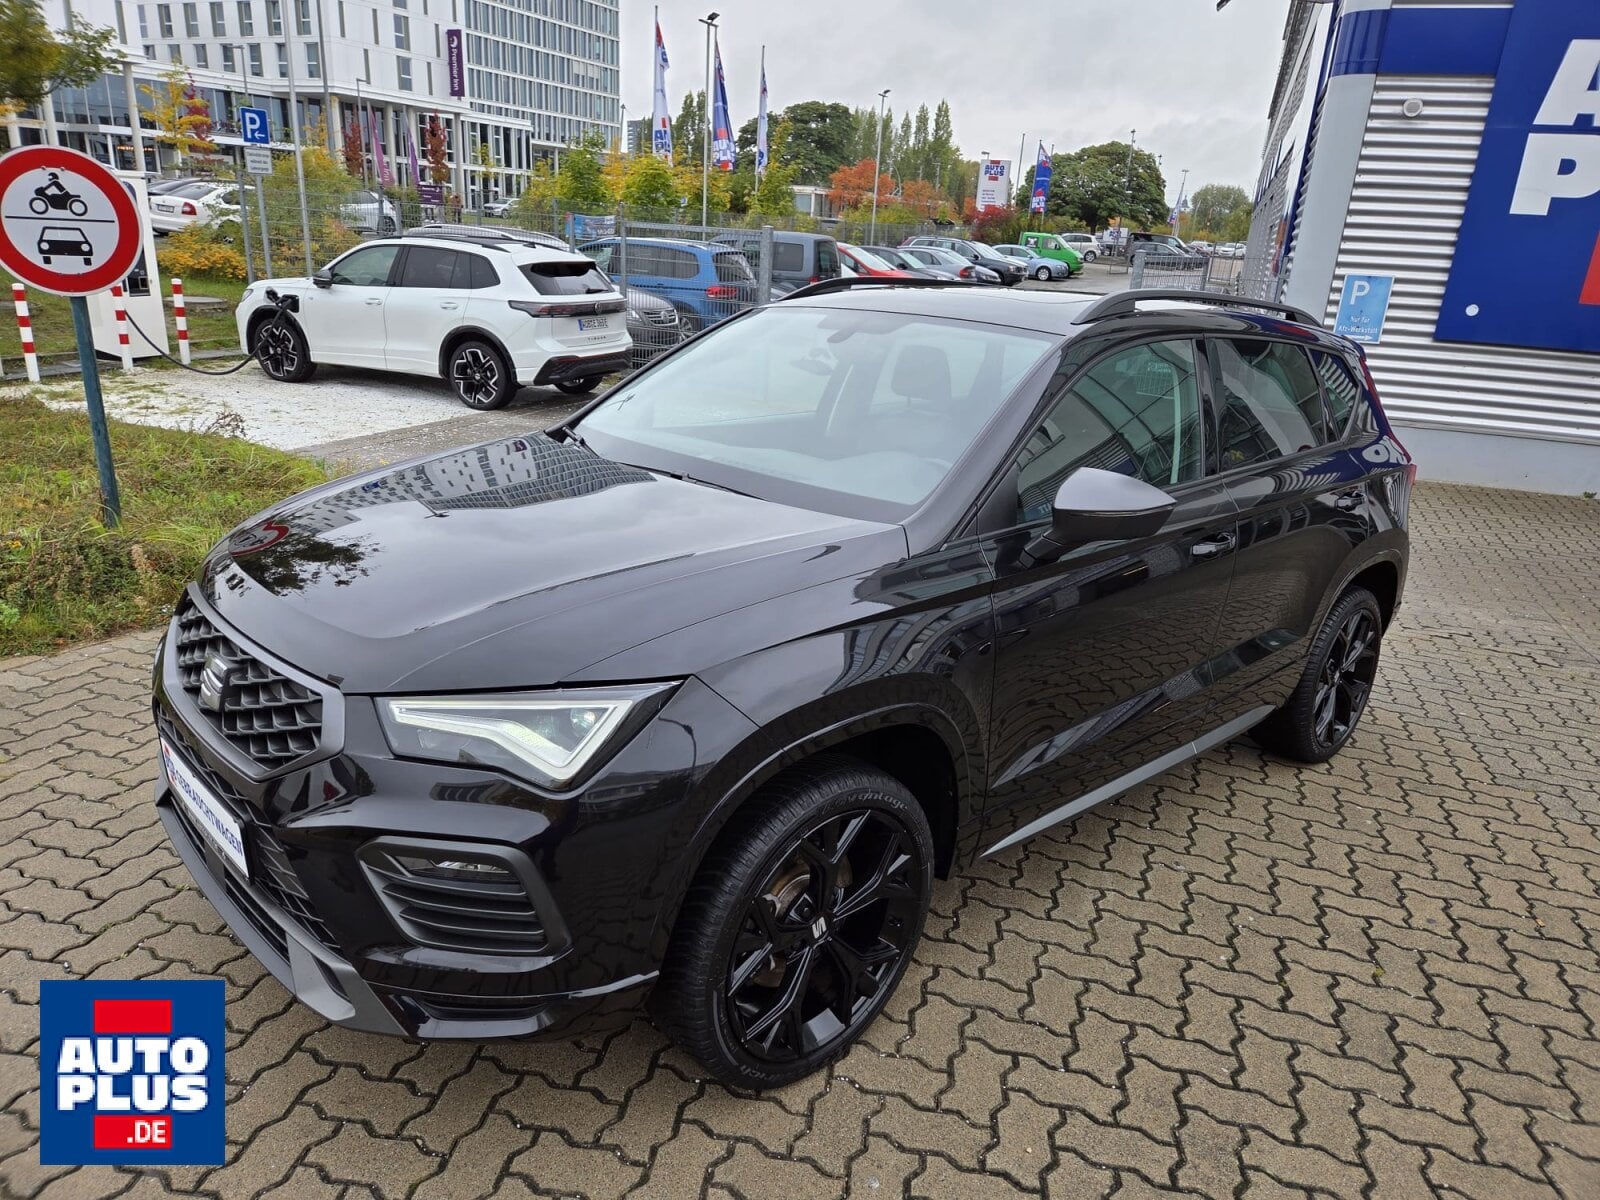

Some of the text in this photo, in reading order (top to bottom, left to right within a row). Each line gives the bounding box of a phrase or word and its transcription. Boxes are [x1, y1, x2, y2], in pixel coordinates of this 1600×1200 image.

[451, 48, 459, 79] Premier
[245, 112, 261, 139] P
[1350, 280, 1370, 305] P
[175, 769, 243, 857] GEBRAUCHTWAGEN
